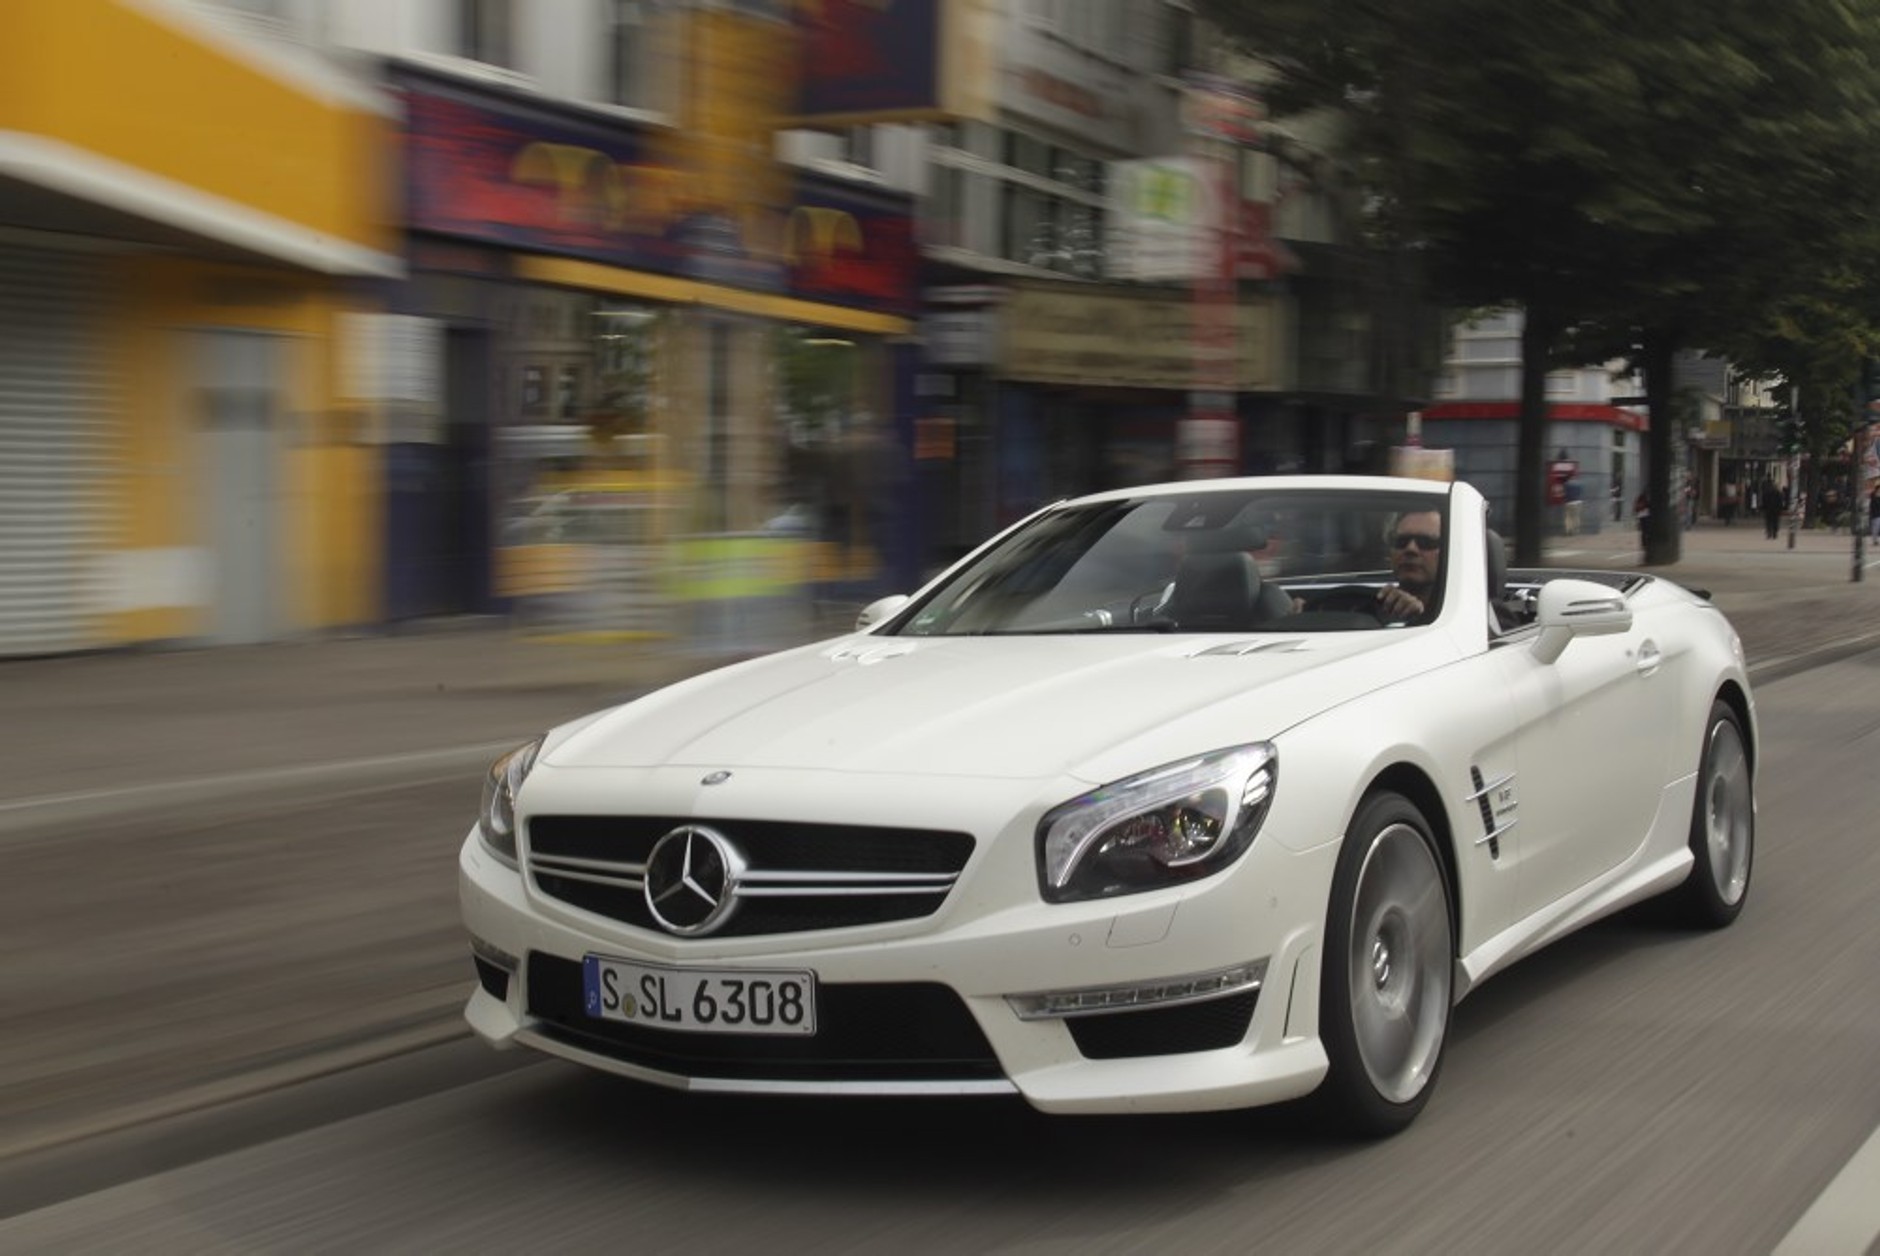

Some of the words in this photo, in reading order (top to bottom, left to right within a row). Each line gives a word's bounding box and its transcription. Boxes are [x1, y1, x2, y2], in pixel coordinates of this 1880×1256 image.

[602, 967, 620, 1011] S
[640, 974, 682, 1023] SL
[692, 979, 805, 1026] 6308
